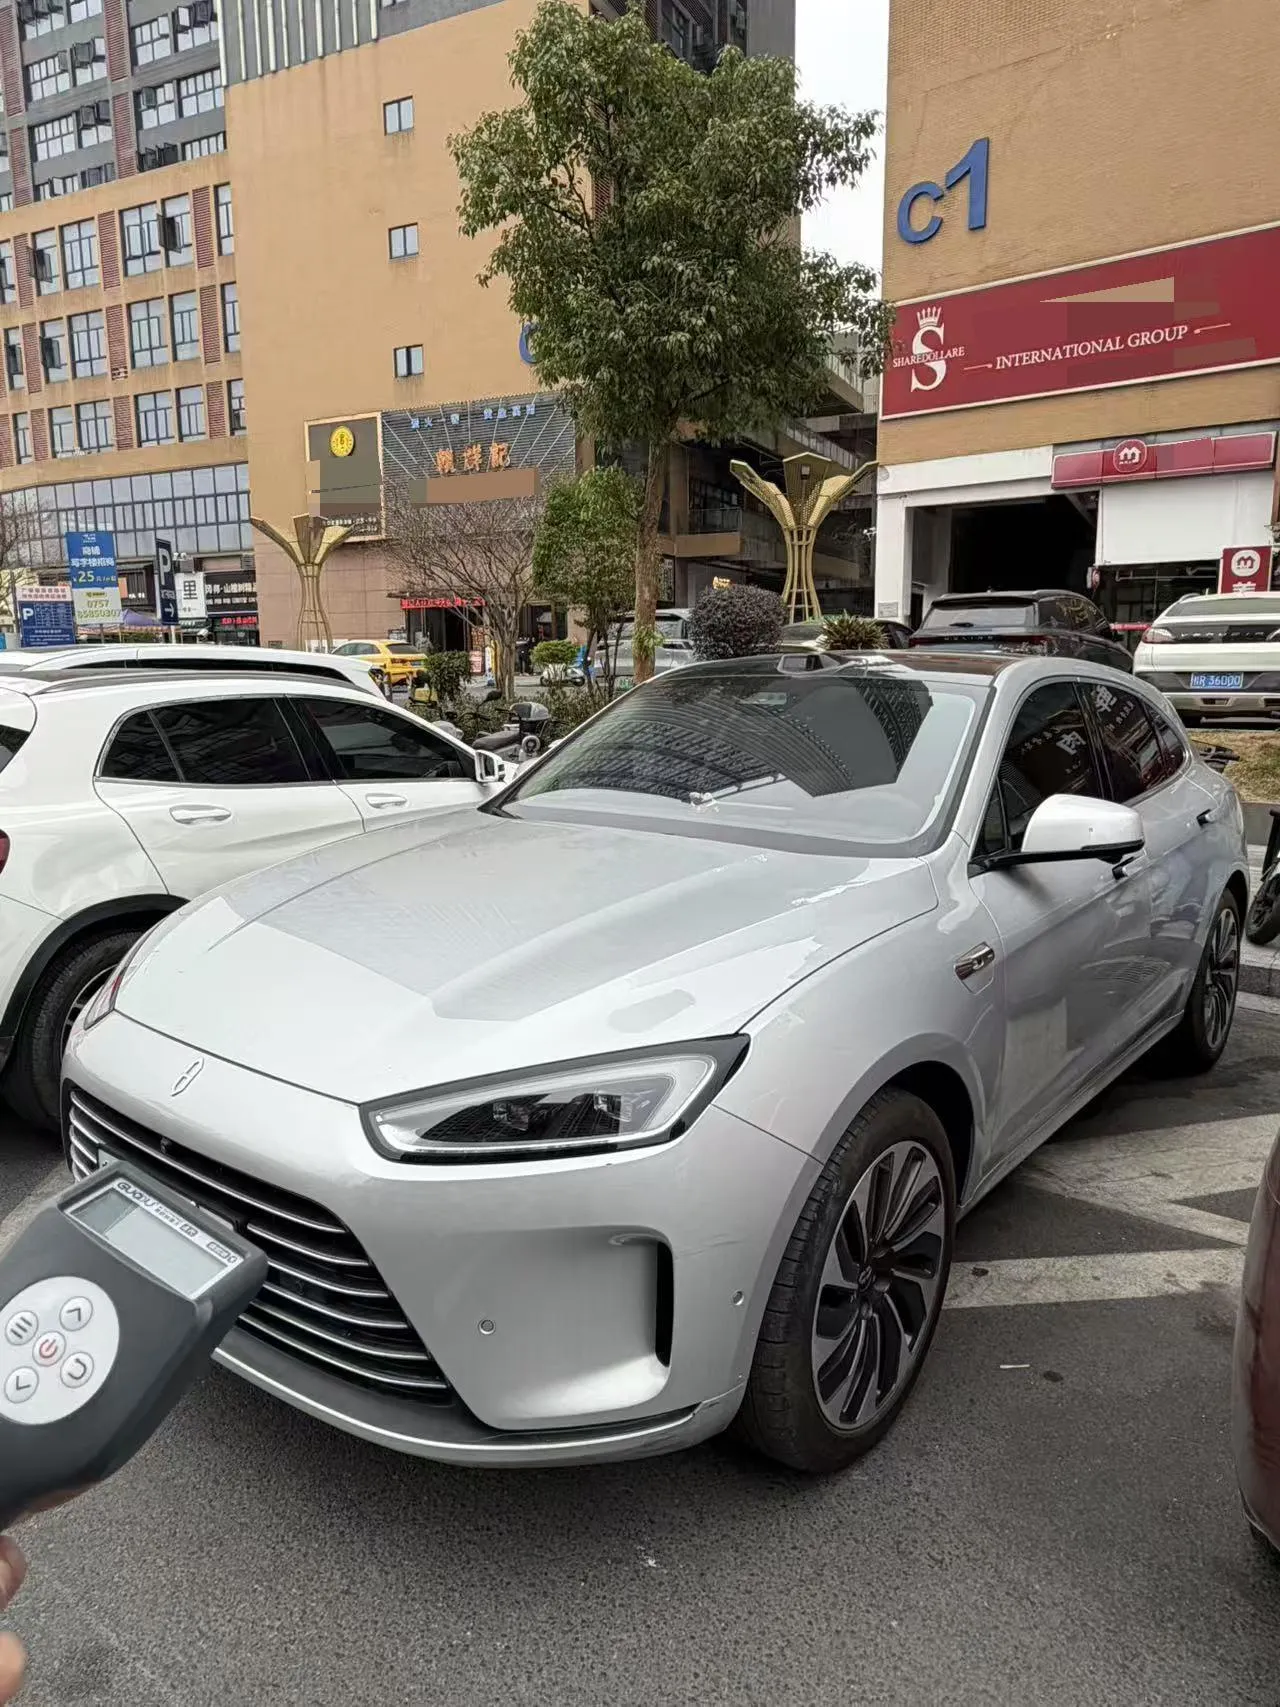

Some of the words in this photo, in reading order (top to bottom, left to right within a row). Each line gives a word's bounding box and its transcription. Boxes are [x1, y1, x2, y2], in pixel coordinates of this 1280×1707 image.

[892, 346, 966, 368] SHAREDOLLARE
[995, 336, 1125, 370] INTERNATIONAL
[1127, 325, 1188, 348] GROUP
[159, 547, 172, 586] P
[22, 607, 34, 620] P
